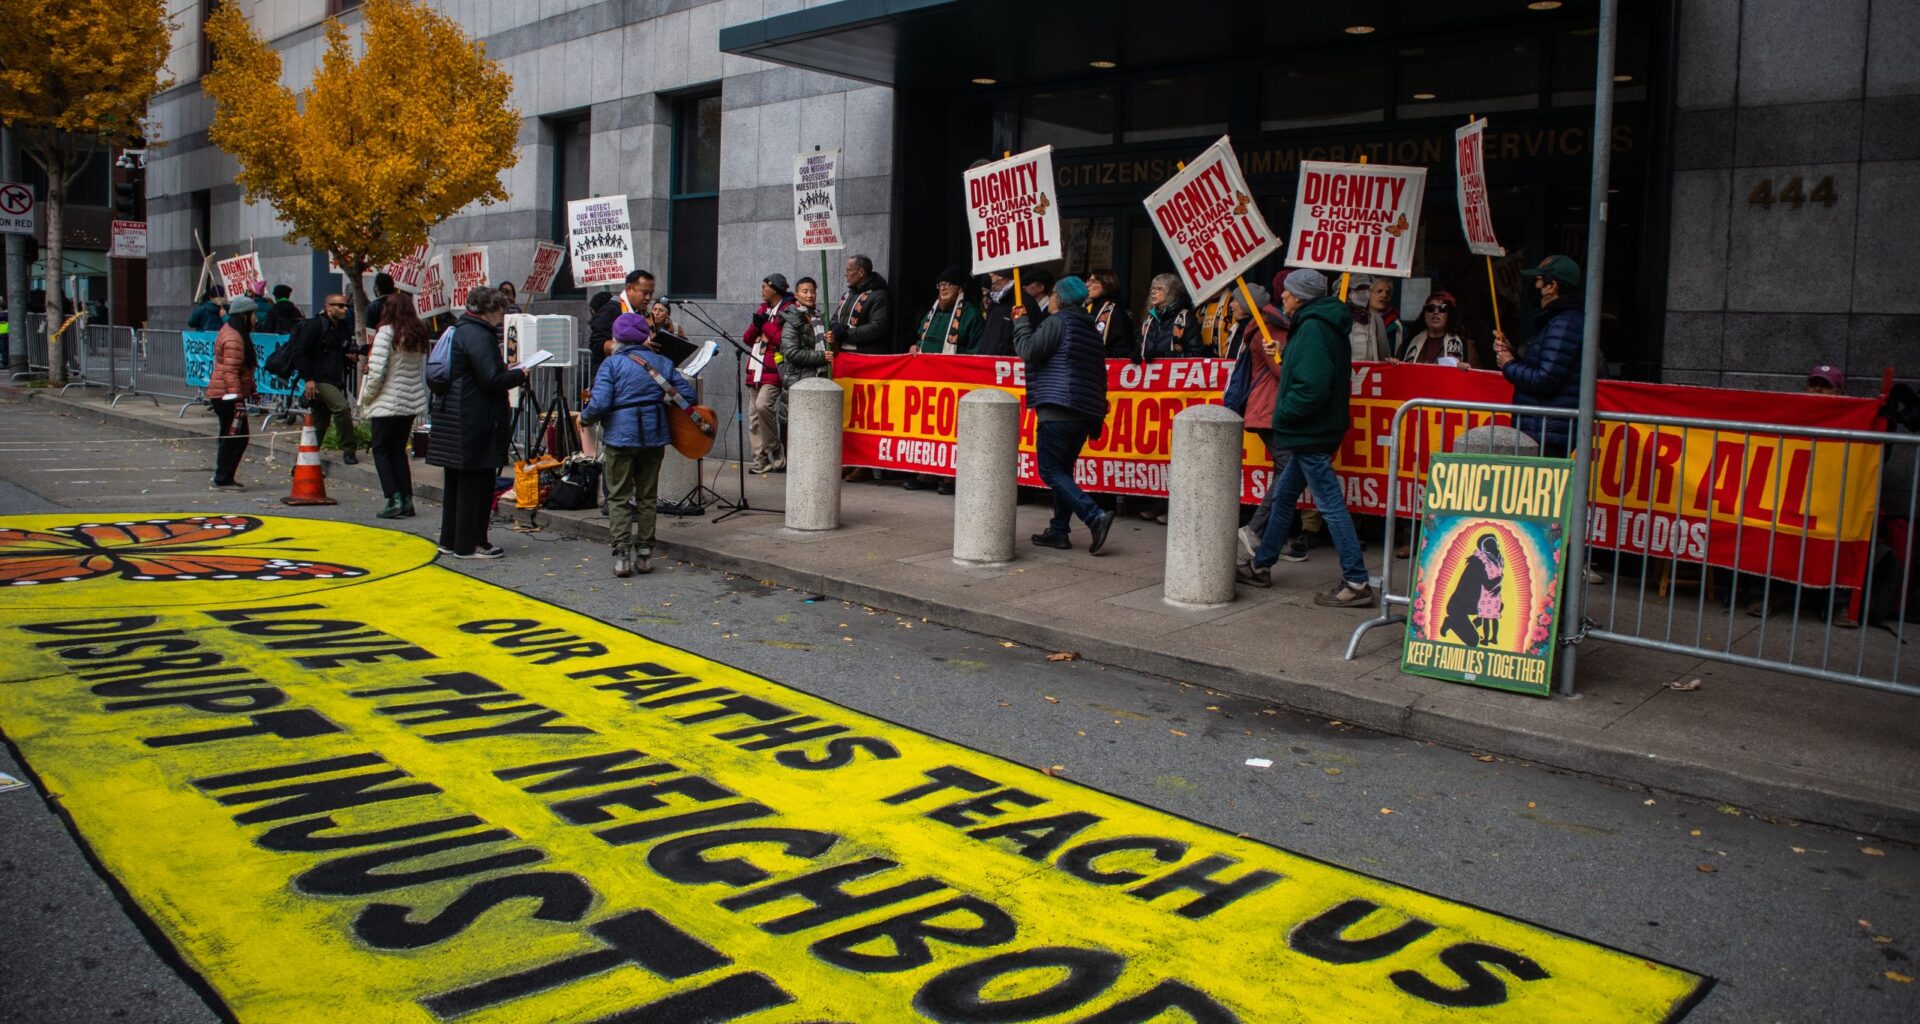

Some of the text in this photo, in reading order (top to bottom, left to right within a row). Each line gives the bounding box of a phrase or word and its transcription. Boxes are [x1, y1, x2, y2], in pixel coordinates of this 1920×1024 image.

[1244, 139, 1441, 174] IMMIGRATION
[970, 160, 1038, 209] DIGNITY
[1303, 172, 1407, 210] DIGNITY
[1748, 176, 1838, 209] 444
[586, 203, 610, 212] PROTECT
[978, 193, 1037, 219] & HUMAN
[1155, 159, 1232, 239] DIGNITY
[15, 218, 33, 229] RED
[573, 222, 630, 235] NUESTROS VECINOS
[577, 208, 624, 221] OUR NEIGHBORS
[986, 207, 1032, 229] RIGHTS
[1176, 195, 1235, 244] & HUMAN
[1311, 206, 1393, 223] & HUMAN
[1318, 219, 1383, 236] RIGHTS
[976, 225, 1011, 261] FOR
[1016, 217, 1049, 252] ALL
[1187, 212, 1235, 252] RIGHTS
[452, 252, 482, 274] DIGNITY
[581, 252, 623, 262] KEEP FAMILIES
[588, 259, 618, 267] TOGETHER
[1183, 215, 1266, 290] FOR ALL
[1296, 230, 1398, 269] FOR ALL
[221, 257, 253, 276] DIGNITY
[403, 268, 418, 287] ALL
[460, 272, 481, 280] HUMAN
[228, 283, 245, 297] FOR
[457, 280, 478, 289] RIGHTS
[418, 290, 446, 314] FOR ALL
[1119, 363, 1163, 389] OF
[1167, 361, 1238, 389] FAIT
[849, 383, 894, 431] ALL
[1693, 440, 1818, 530] ALL
[878, 437, 894, 462] EL
[896, 439, 947, 468] PUEBLO
[1102, 460, 1170, 492] PERSON
[1619, 510, 1708, 559] TODOS
[1428, 462, 1570, 518] SANCTUARY
[199, 602, 443, 669] LOVE
[344, 670, 602, 745] THY
[1406, 641, 1546, 684] KEEP FAMILIES TOGETHER
[18, 614, 345, 749] DISRUPT
[457, 617, 1553, 1010] OUR FAITHS TEACH US
